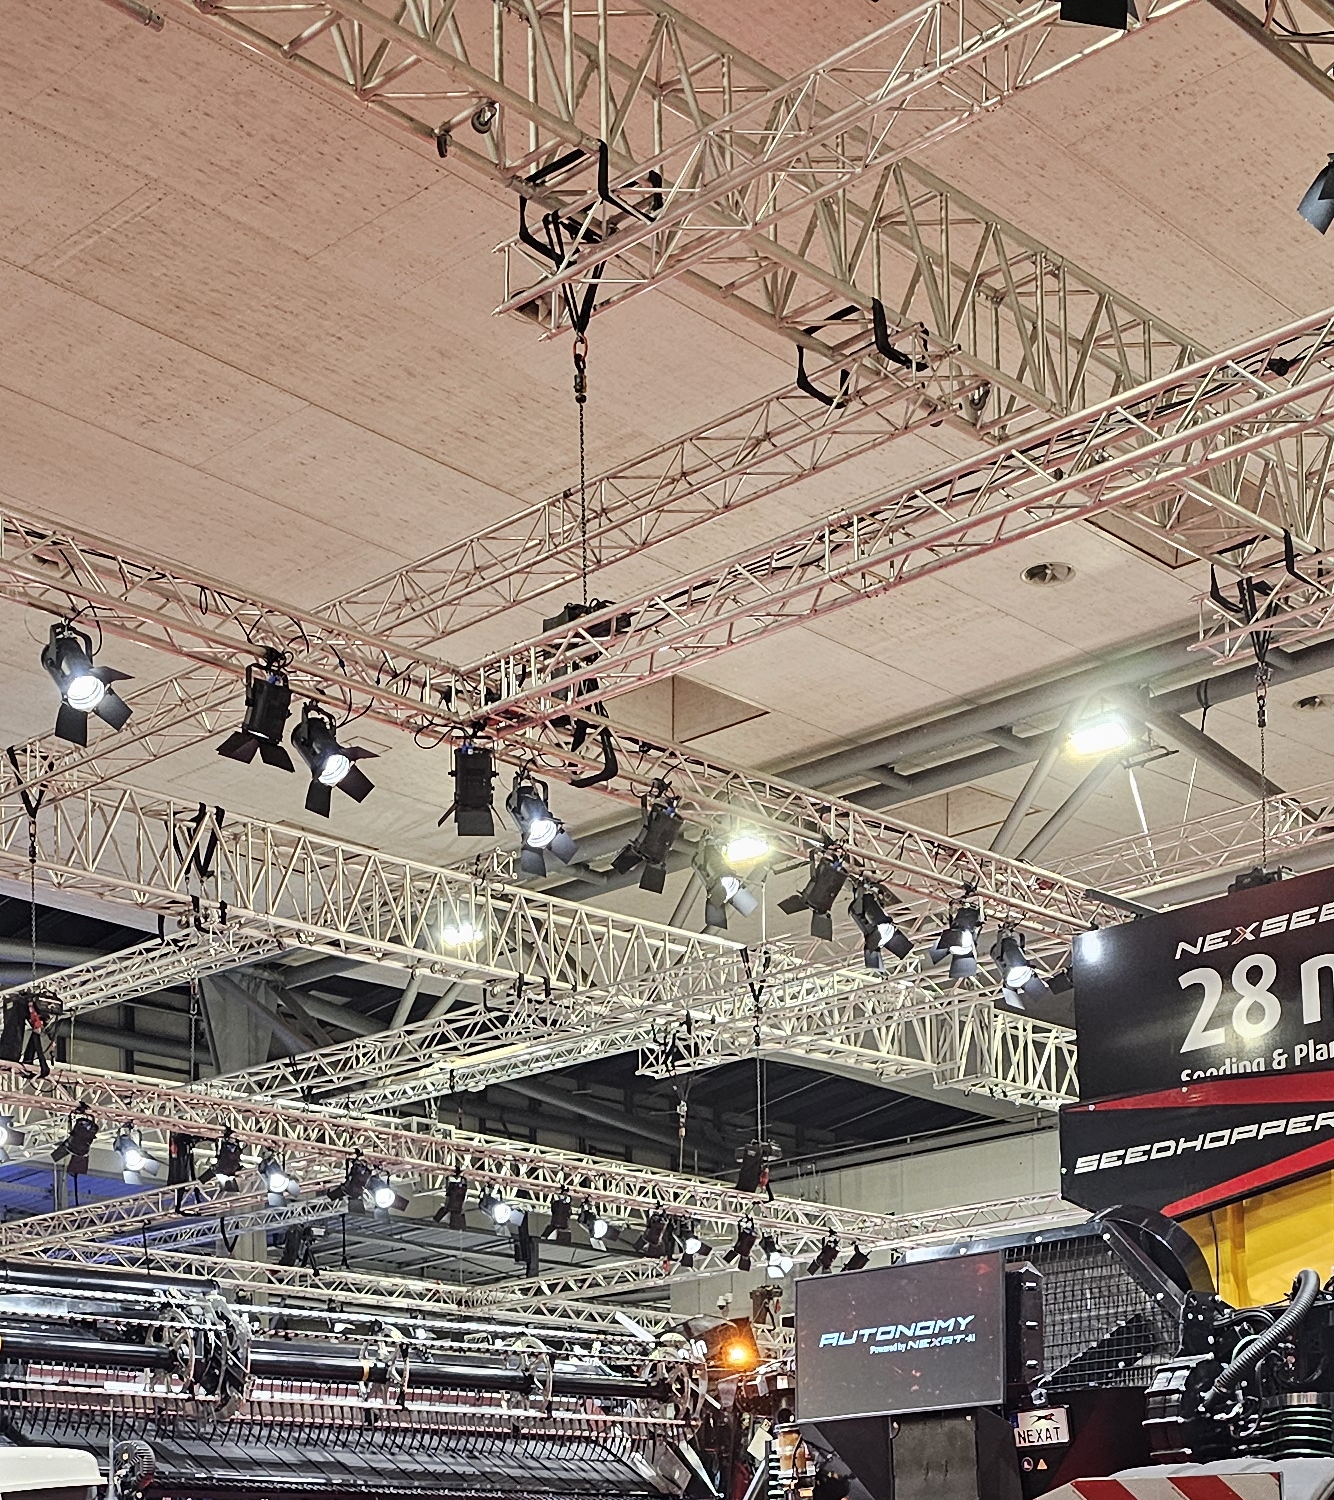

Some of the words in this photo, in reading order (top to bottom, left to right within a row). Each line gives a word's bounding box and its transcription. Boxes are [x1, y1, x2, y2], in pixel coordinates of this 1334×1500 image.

[1177, 953, 1282, 1054] 28
[1272, 1048, 1288, 1070] &
[818, 1314, 975, 1348] AUTONOMY
[1016, 1426, 1061, 1445] NEXAT
